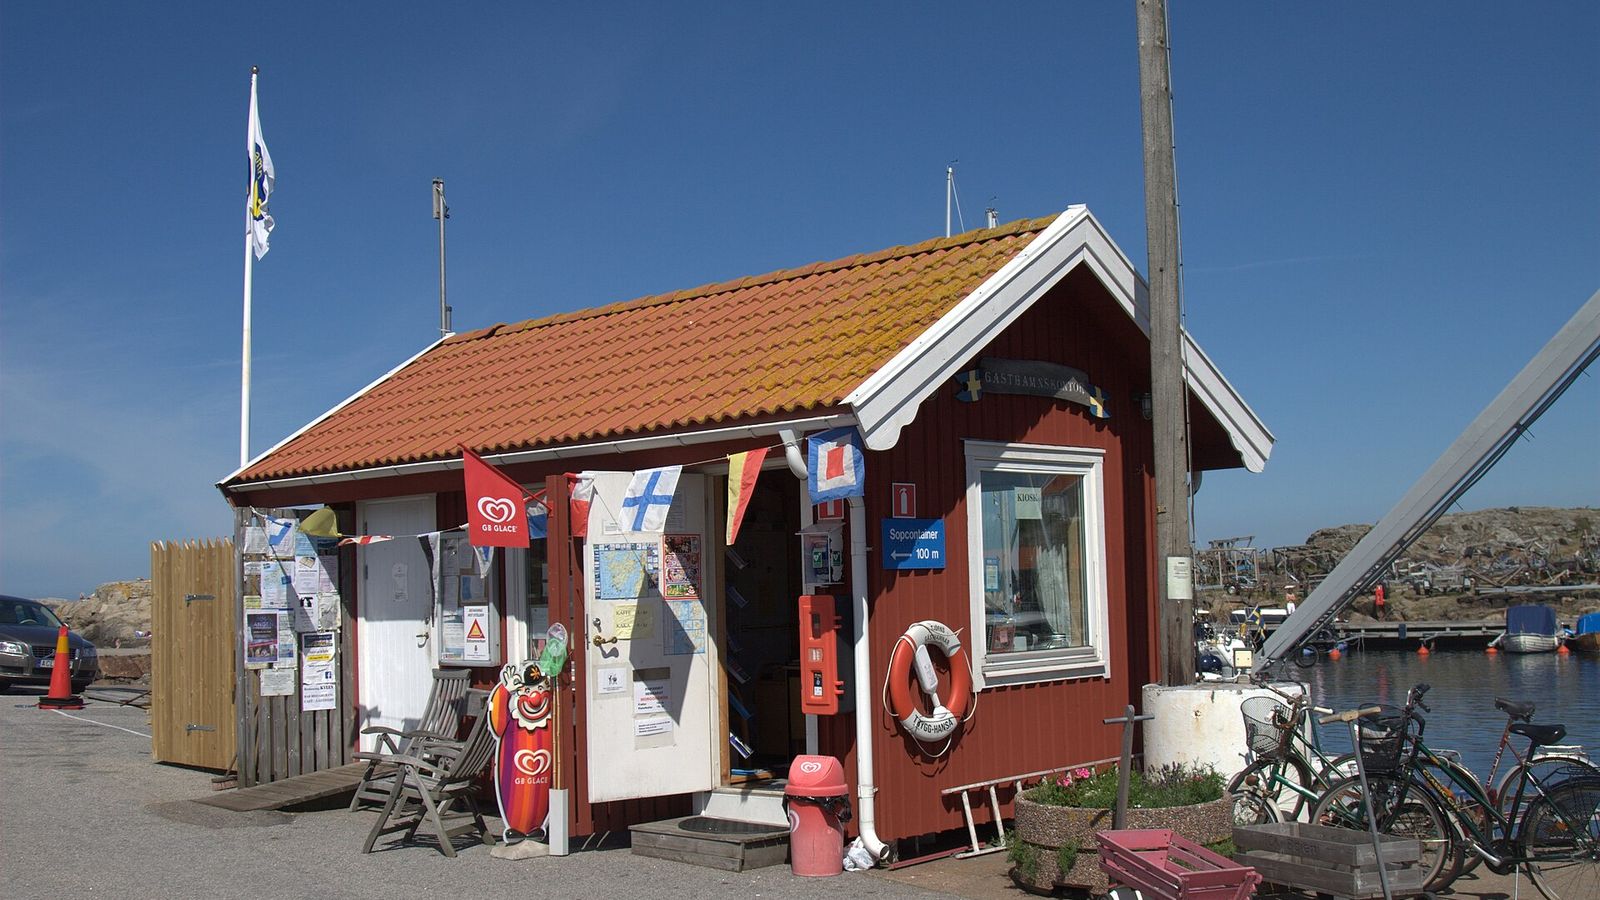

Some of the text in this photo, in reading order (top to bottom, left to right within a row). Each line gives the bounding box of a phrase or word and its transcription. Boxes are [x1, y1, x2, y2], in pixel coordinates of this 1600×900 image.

[1017, 493, 1039, 502] KIOSK
[482, 524, 516, 533] GB GLACE
[890, 528, 938, 543] Sopcontainer
[916, 548, 939, 559] 100 m
[526, 777, 548, 785] GLACE
